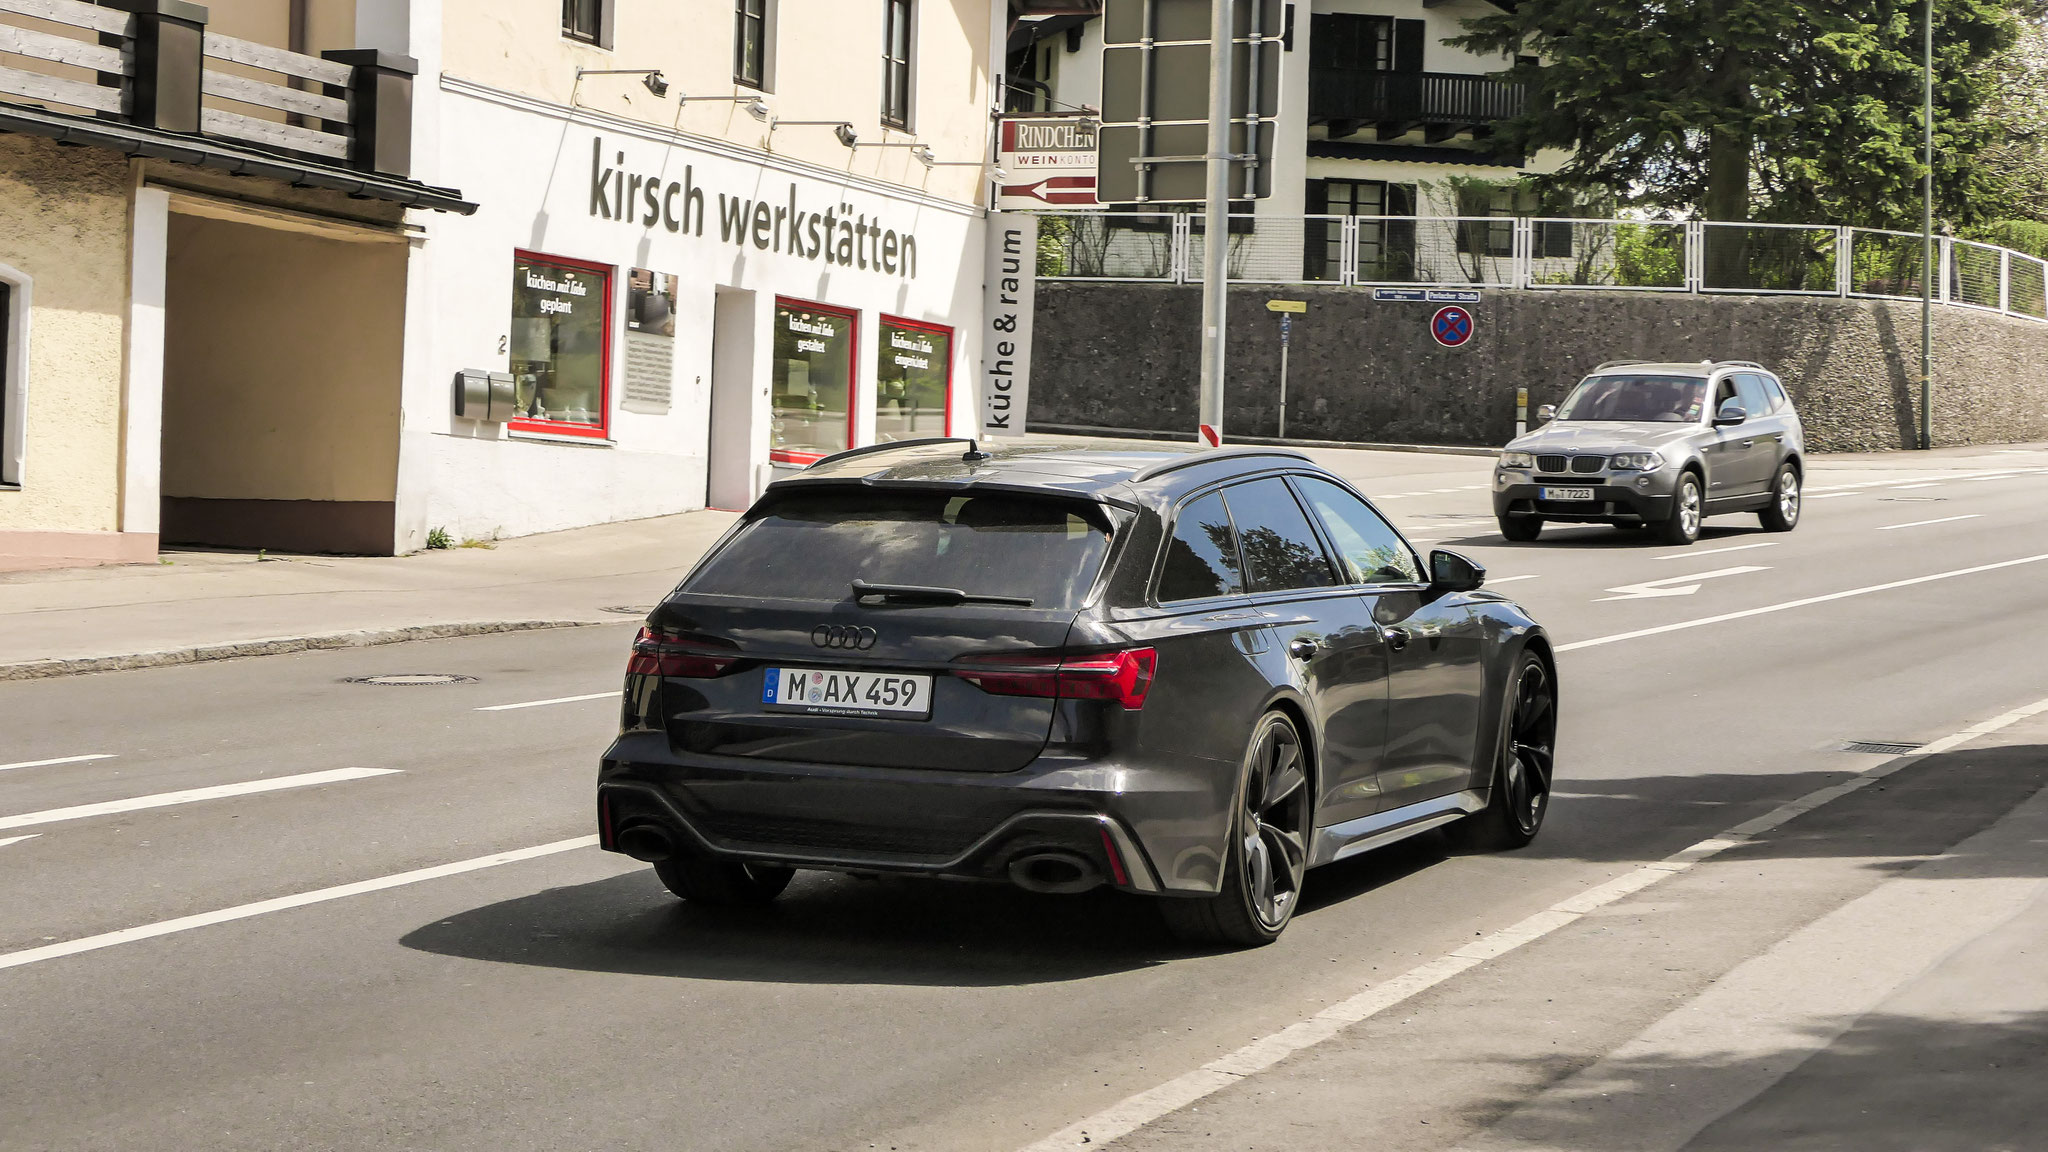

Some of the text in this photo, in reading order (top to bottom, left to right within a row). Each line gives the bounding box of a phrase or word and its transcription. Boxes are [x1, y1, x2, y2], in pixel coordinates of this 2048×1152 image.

[1018, 124, 1094, 148] RINDCHEN
[590, 137, 916, 279] kirsch werkstätten
[527, 269, 556, 291] küchen
[540, 298, 572, 314] geplant
[789, 314, 811, 333] küchen
[986, 229, 1021, 429] küche & raum
[498, 335, 507, 354] 2
[1567, 489, 1590, 499] 7223
[767, 689, 773, 697] D
[788, 673, 917, 707] M AX 459
